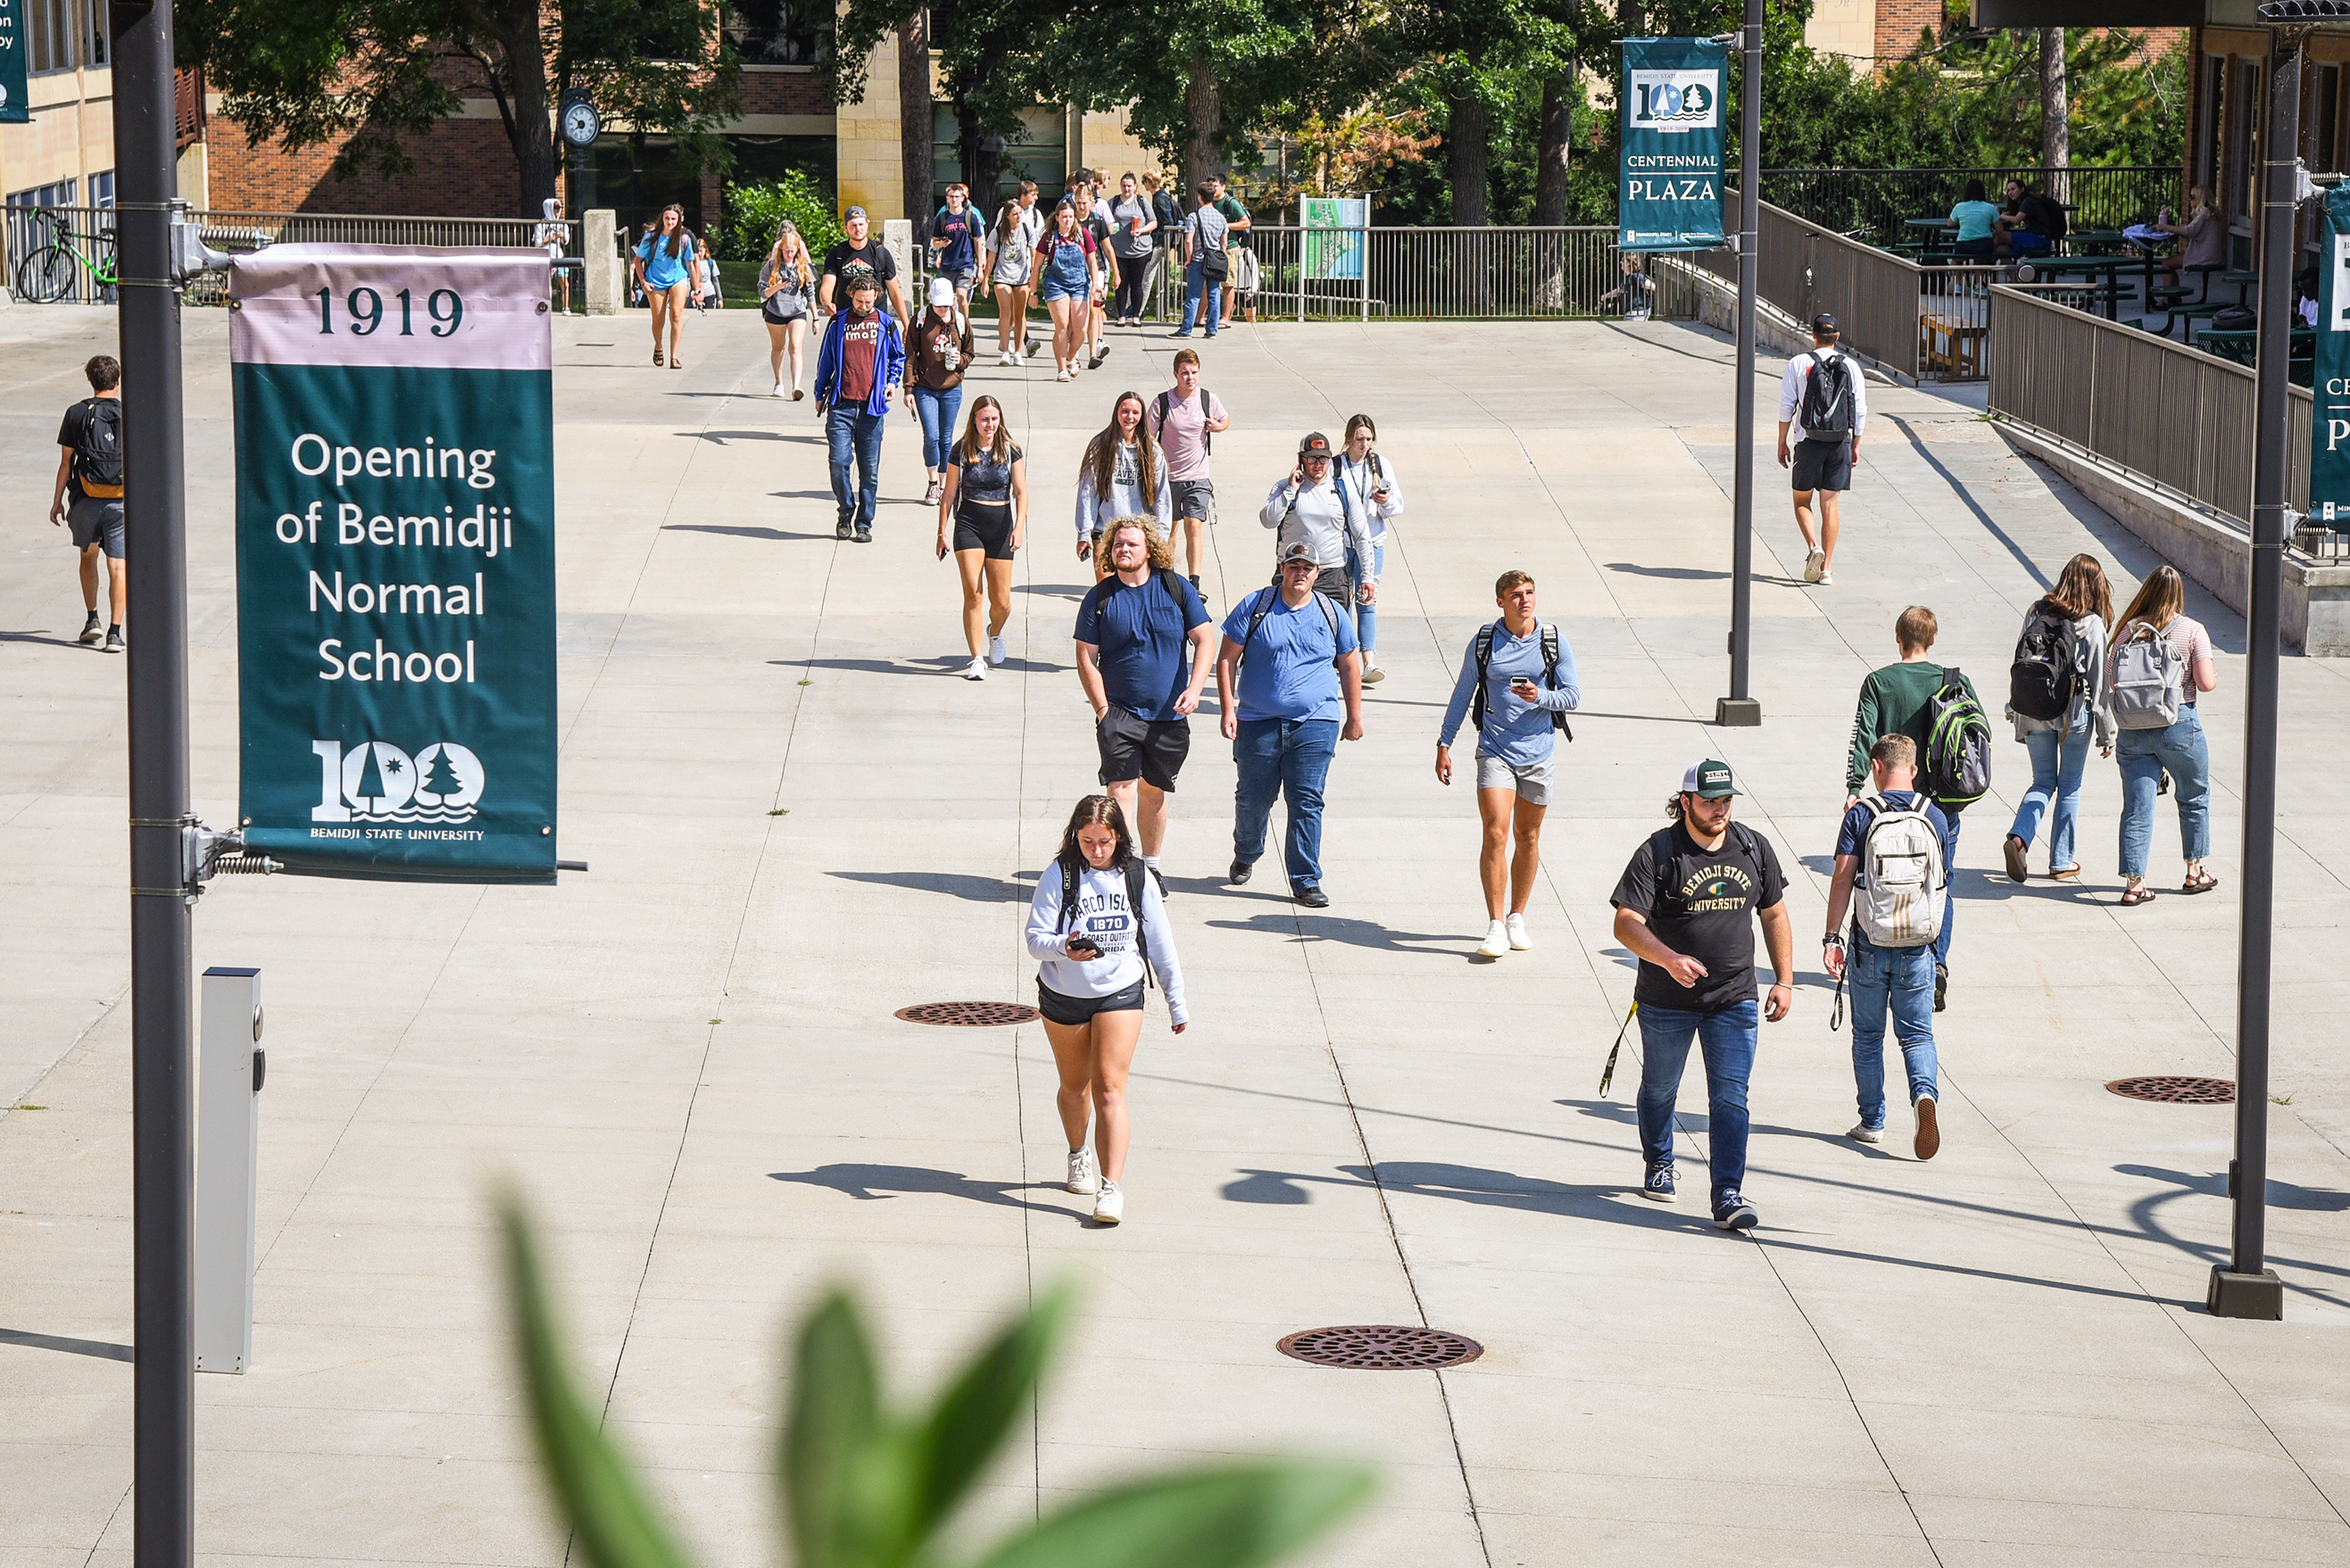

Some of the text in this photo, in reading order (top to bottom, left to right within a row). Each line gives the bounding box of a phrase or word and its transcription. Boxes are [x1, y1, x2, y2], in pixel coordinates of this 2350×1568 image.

[1627, 155, 1718, 167] CENTENNIAL
[1628, 179, 1716, 200] PLAZA
[316, 286, 463, 337] 1919
[861, 331, 869, 339] a
[291, 433, 496, 489] Opening
[275, 501, 512, 558] of Bemidji
[310, 570, 484, 615] Normal
[319, 638, 475, 684] School
[310, 827, 485, 841] BEMIDJI STATE UNIVERSITY
[1682, 865, 1752, 897] BEMIDJI STATE
[1067, 893, 1130, 920] ARCO ISL
[1687, 897, 1746, 912] UNIVERSITY
[1093, 917, 1123, 930] 1870
